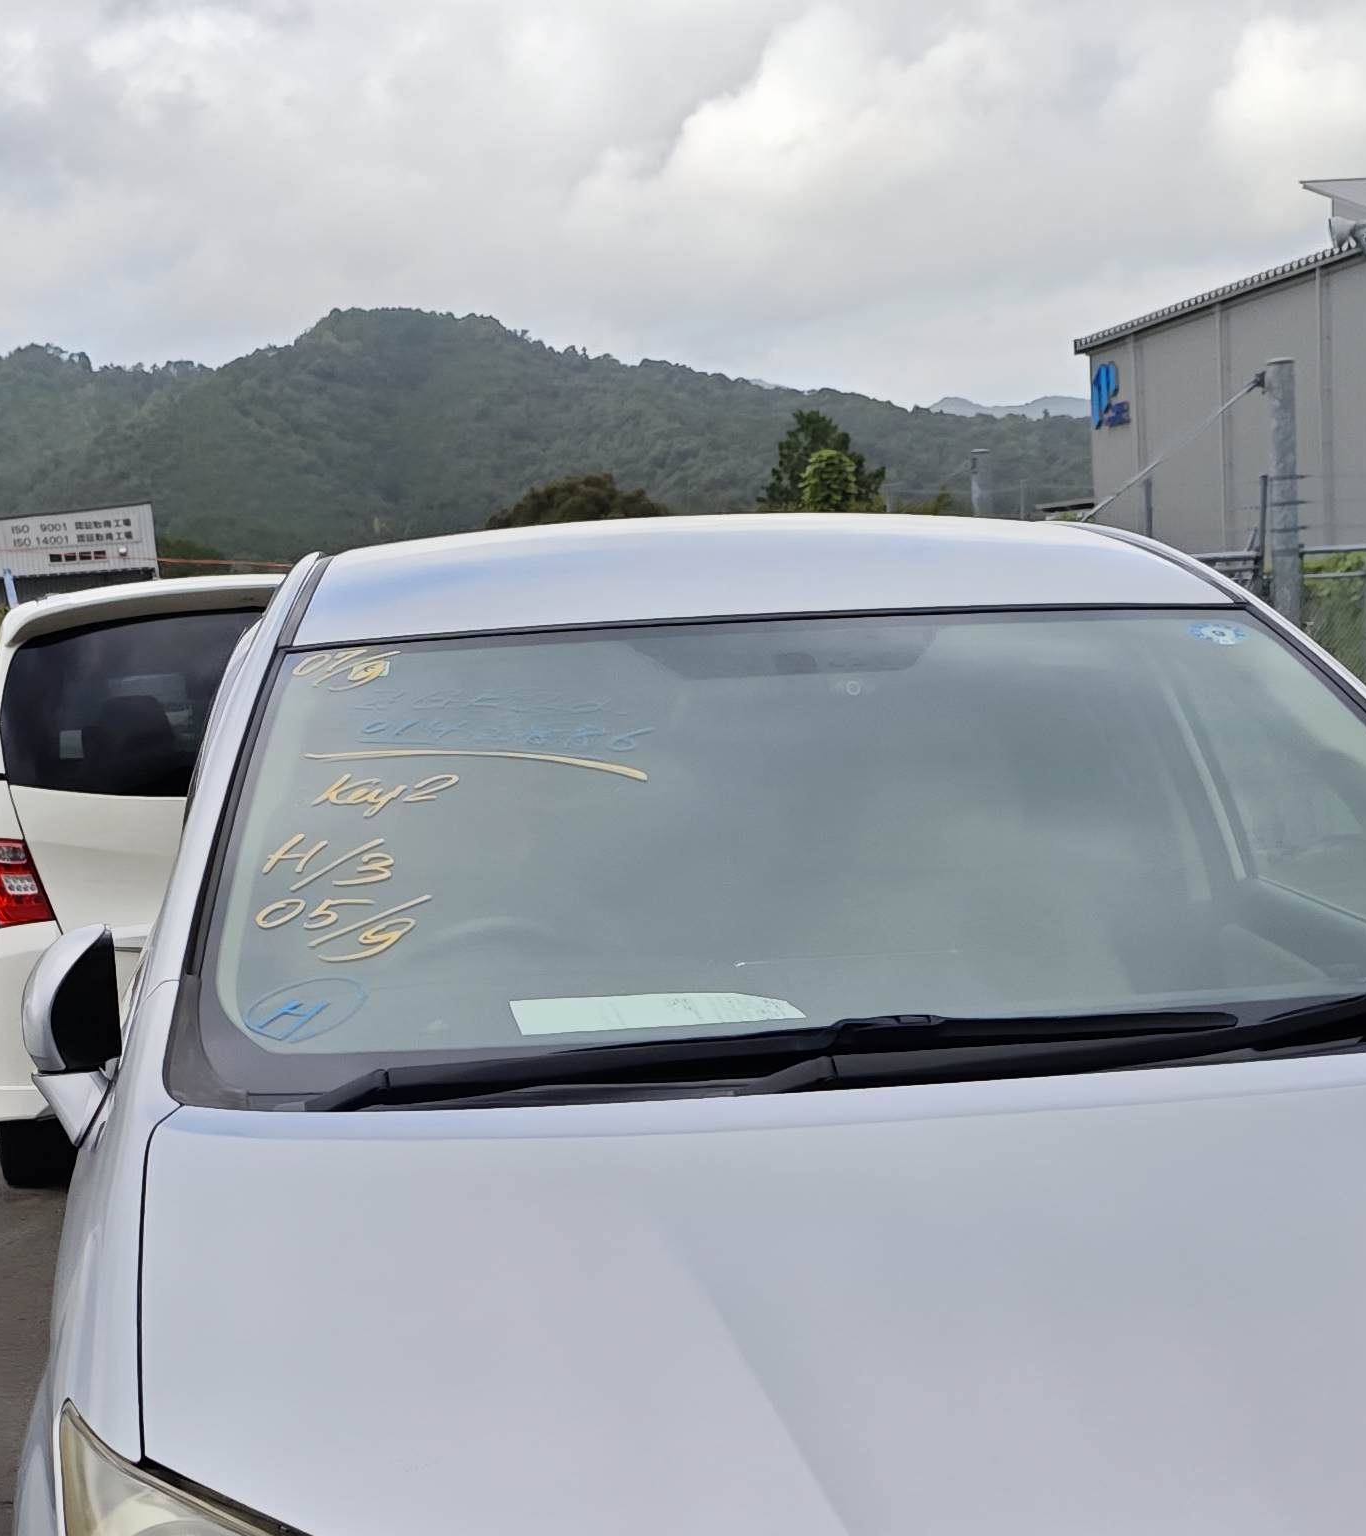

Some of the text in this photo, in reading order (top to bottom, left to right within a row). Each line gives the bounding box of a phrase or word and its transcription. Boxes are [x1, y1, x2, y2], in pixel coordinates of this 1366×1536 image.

[11, 524, 30, 535] ISO
[40, 522, 68, 533] 9001
[13, 537, 31, 547] ISO
[36, 535, 69, 546] 14001
